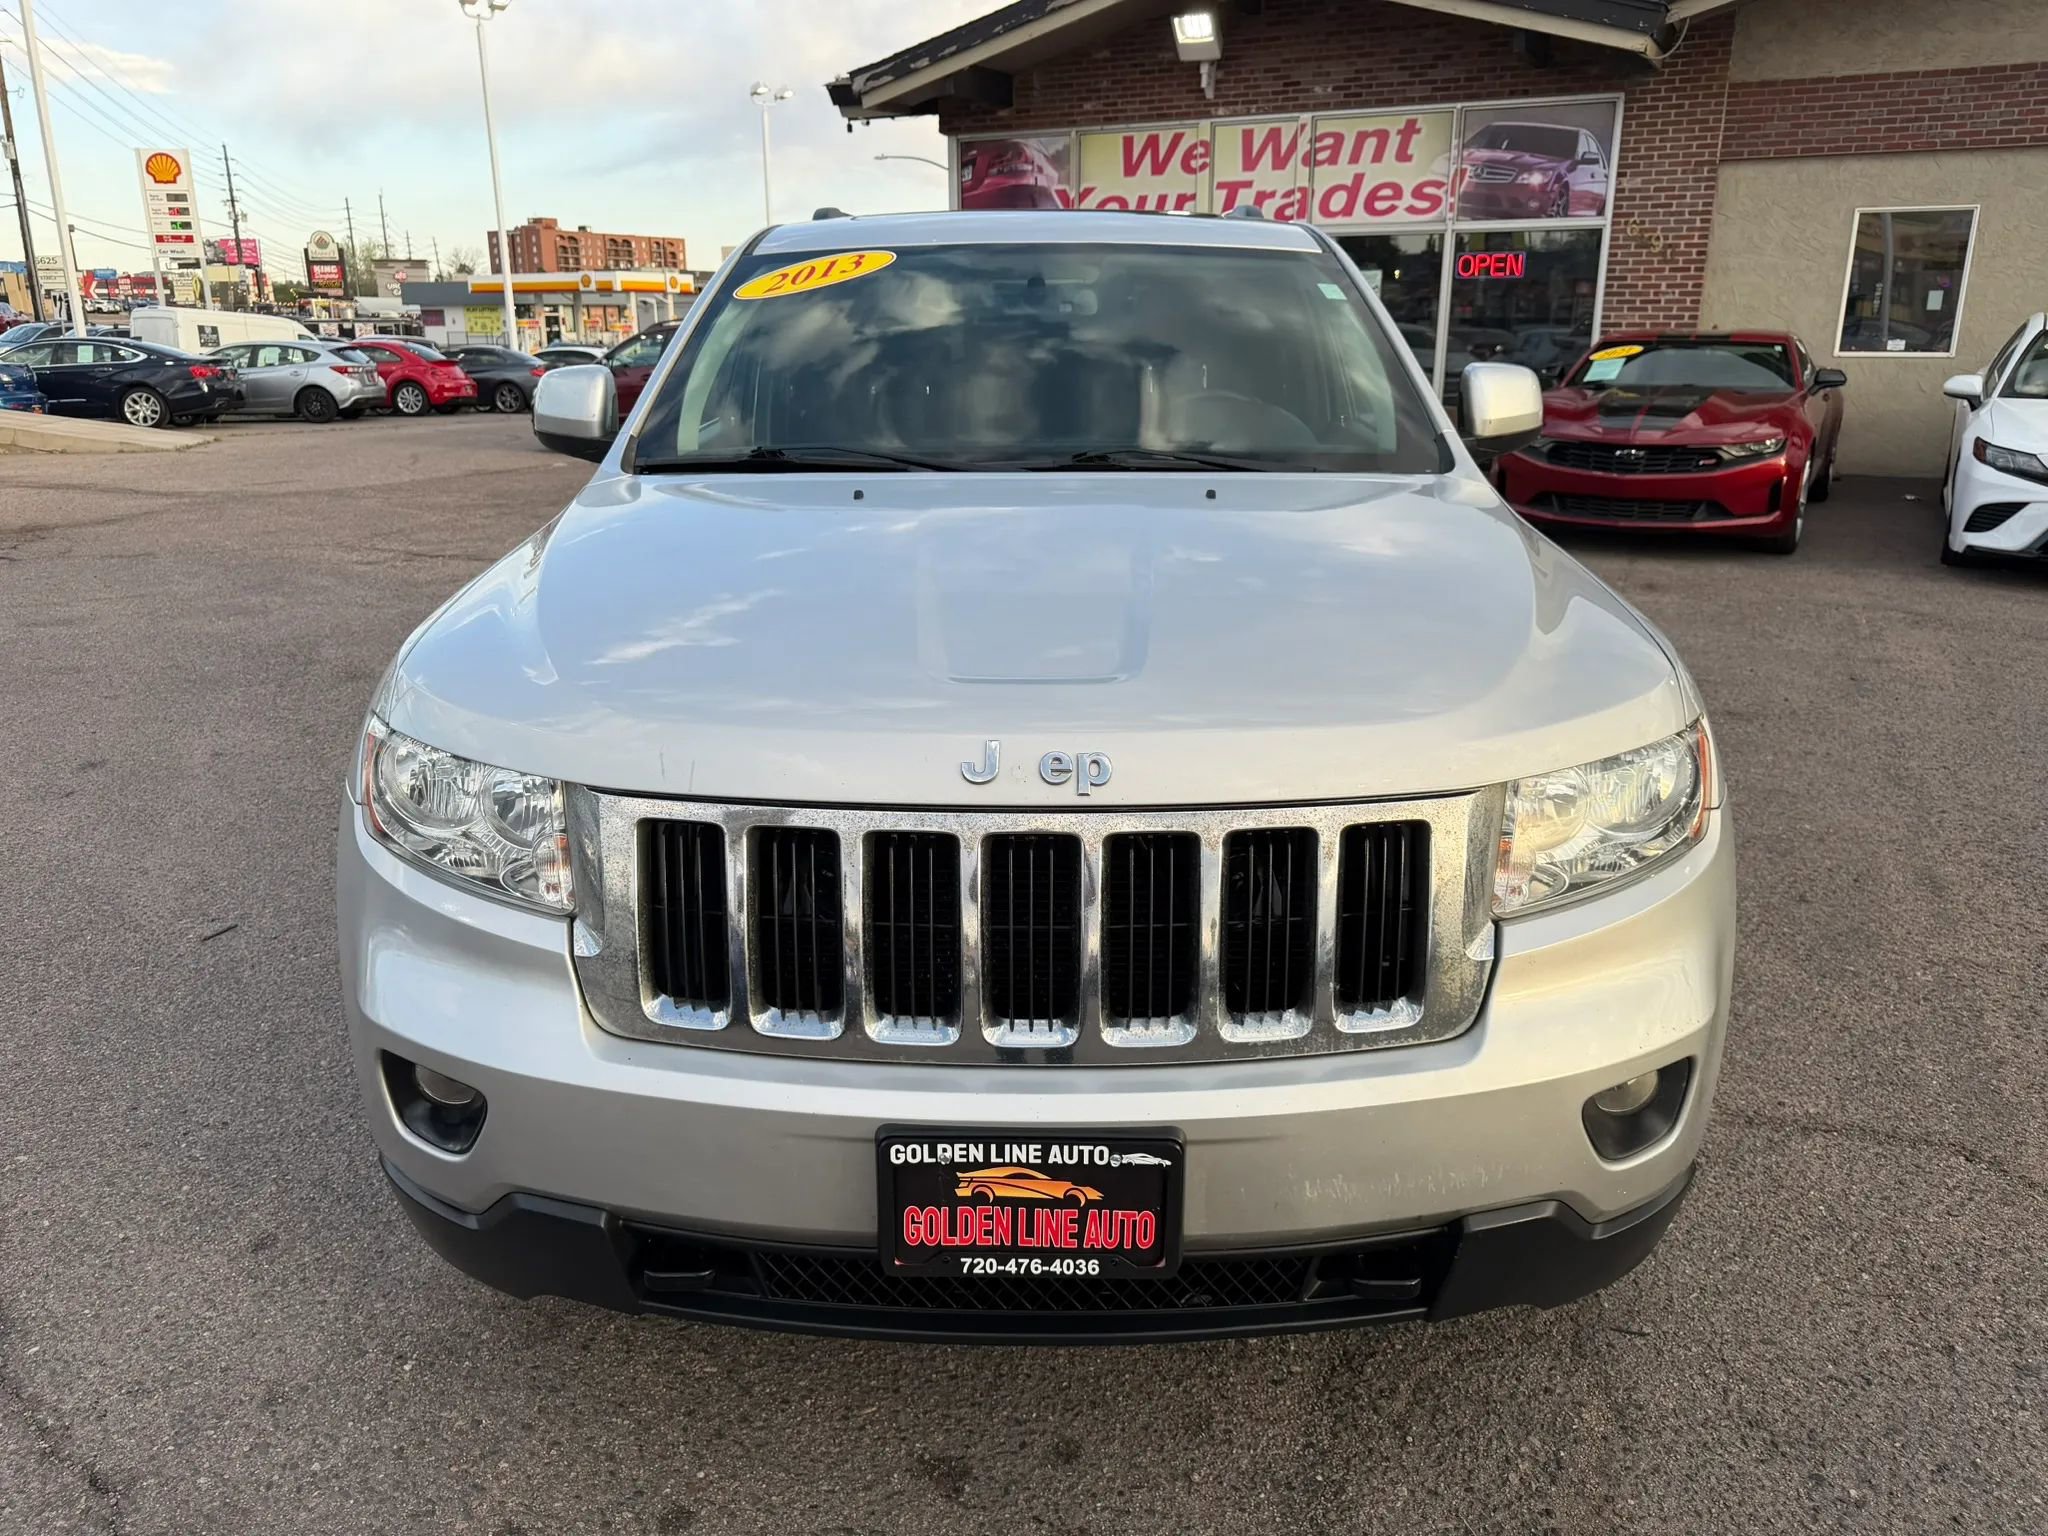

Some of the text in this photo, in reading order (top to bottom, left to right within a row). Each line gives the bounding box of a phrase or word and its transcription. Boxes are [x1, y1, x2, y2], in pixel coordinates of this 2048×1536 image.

[1122, 118, 1422, 177] We Want
[1215, 173, 1468, 221] Trades!
[763, 254, 866, 294] 2013
[1458, 253, 1523, 278] OPEN
[890, 1143, 1110, 1165] GOLDEN LINE AUTO
[903, 1205, 1156, 1250] GOLDEN LINE AUTO
[960, 1257, 1101, 1276] 720-476-4036
